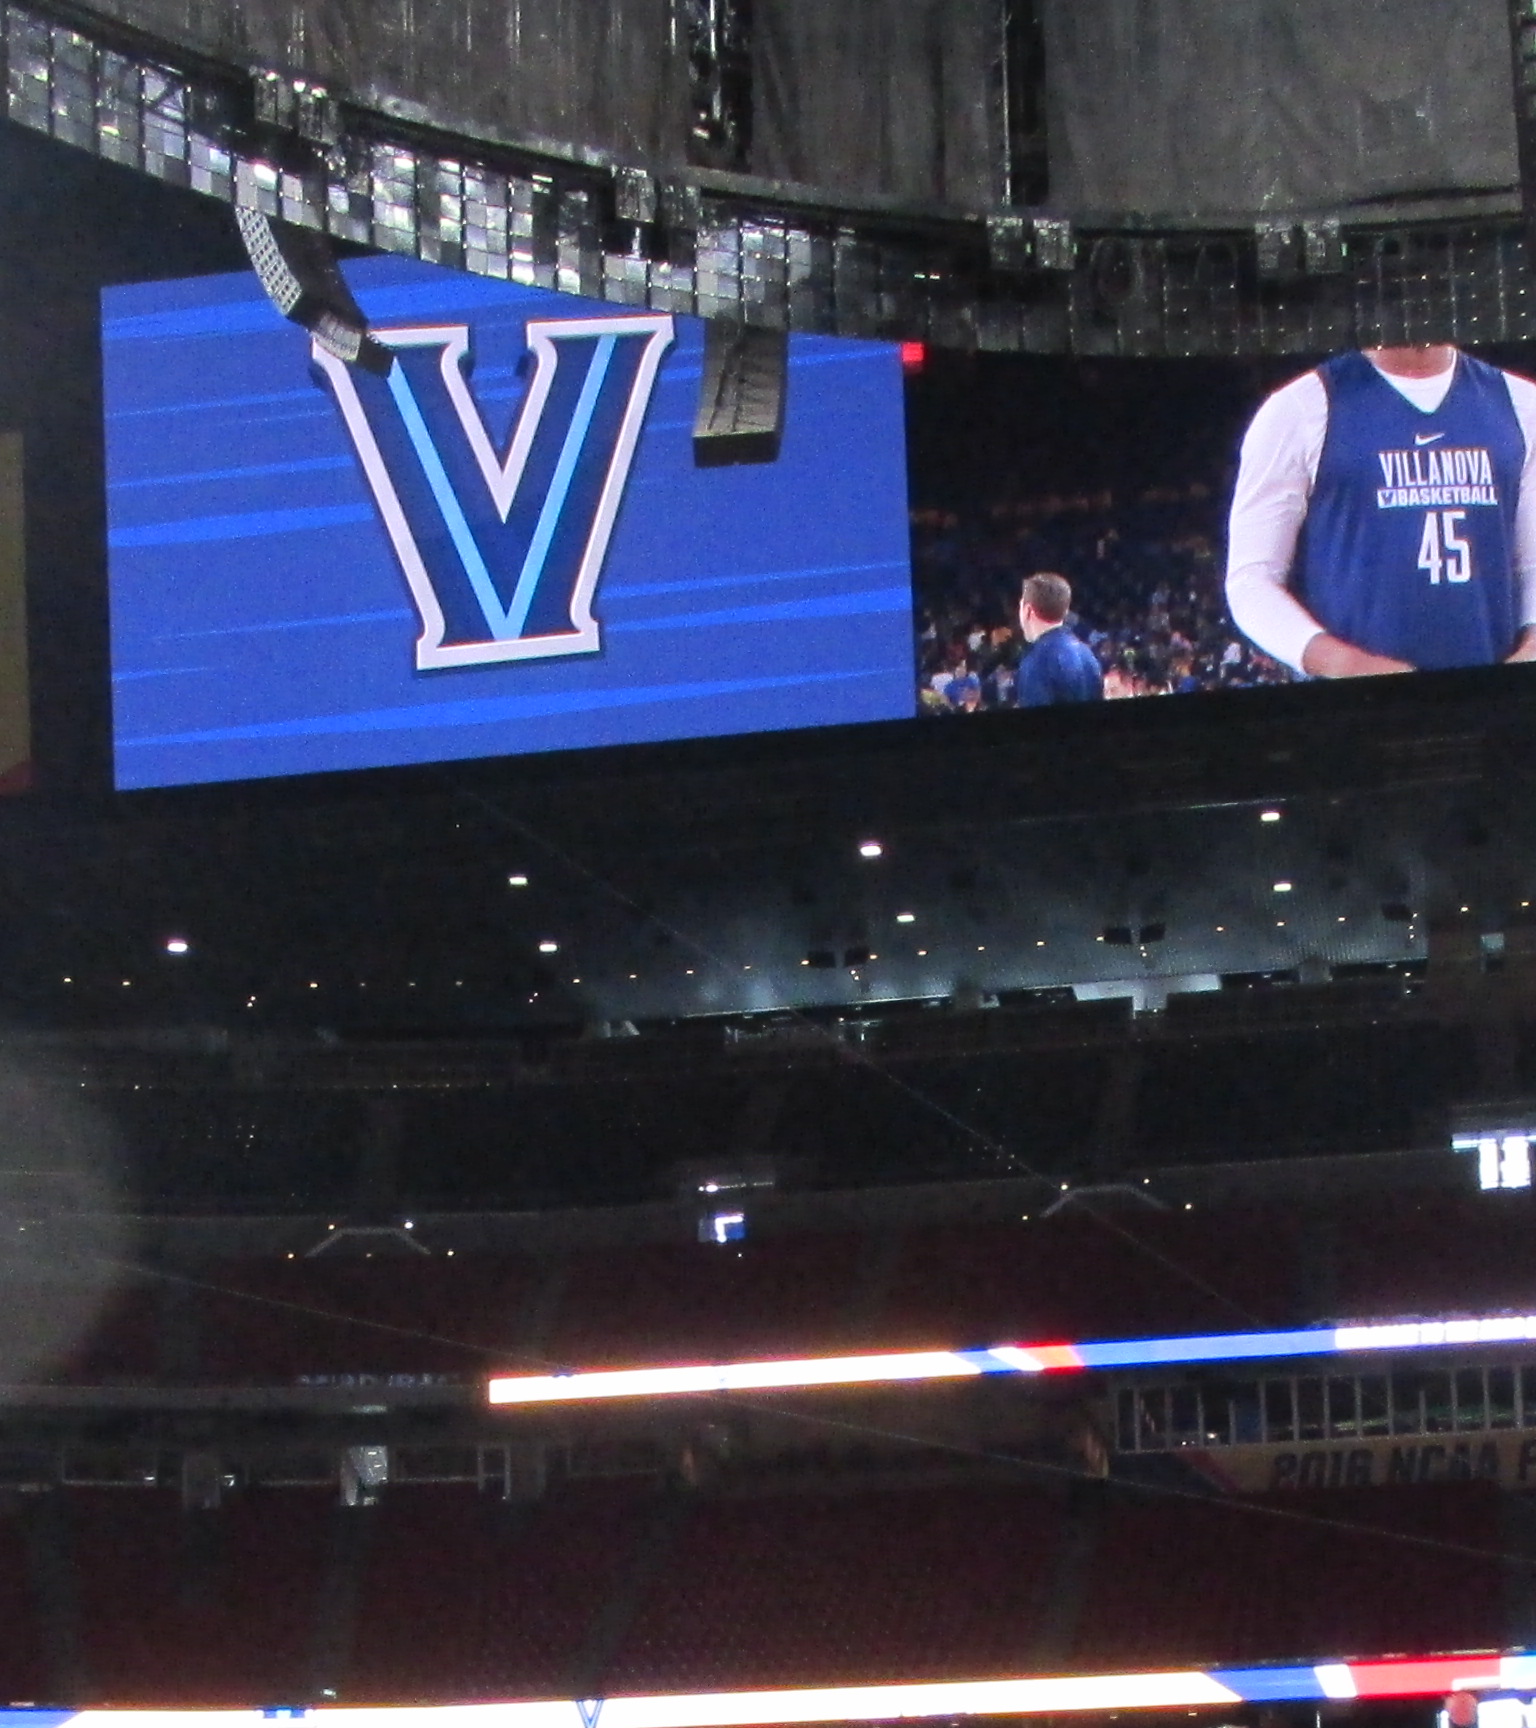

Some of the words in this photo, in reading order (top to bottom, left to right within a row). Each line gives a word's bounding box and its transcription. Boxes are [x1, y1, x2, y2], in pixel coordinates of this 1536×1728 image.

[311, 316, 679, 670] V
[1378, 450, 1493, 487] VILLANOVA
[1398, 486, 1498, 506] BASKETBALL
[1417, 510, 1471, 584] 45
[1274, 1447, 1375, 1491] 2016
[1387, 1441, 1499, 1484] NCAA
